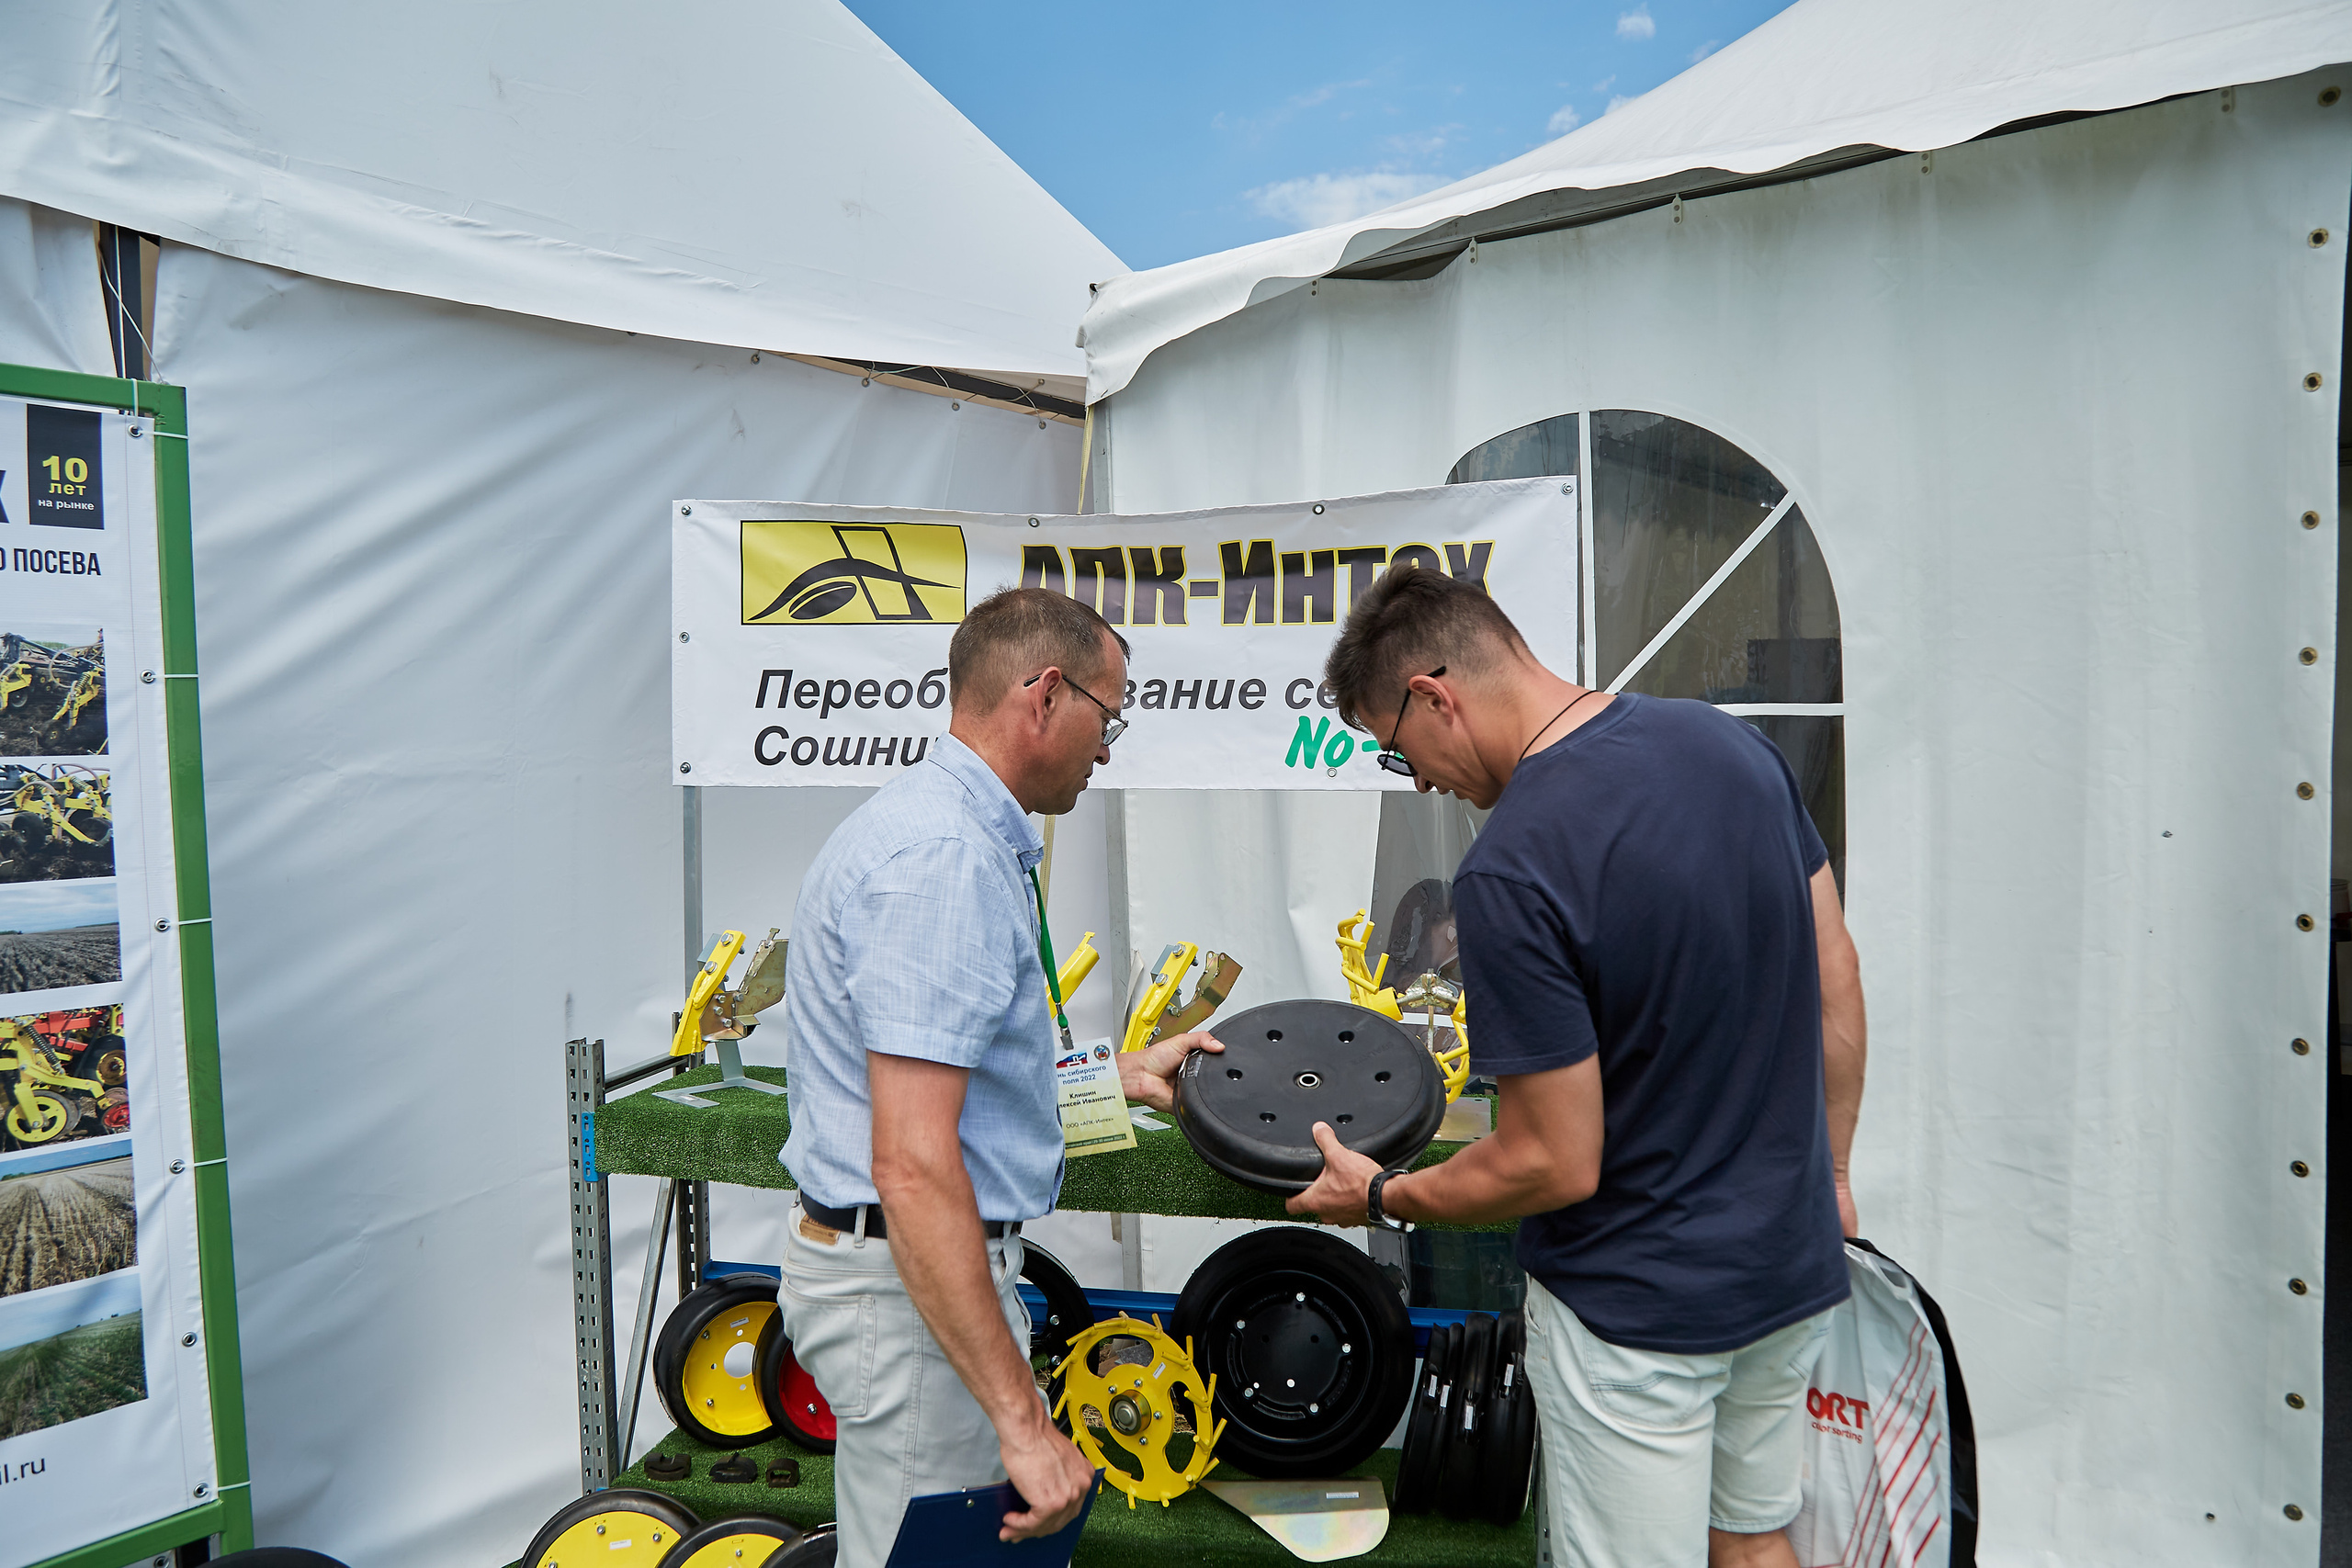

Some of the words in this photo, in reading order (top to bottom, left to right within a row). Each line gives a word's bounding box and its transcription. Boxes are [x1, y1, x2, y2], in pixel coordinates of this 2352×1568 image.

[42, 456, 88, 483] 10
[49, 483, 86, 496] лет
[39, 499, 54, 508] на
[56, 500, 95, 511] рынке
[14, 548, 102, 576] ПОСЕВА
[754, 726, 939, 766] Сошни
[1068, 1066, 1107, 1077] сибирского
[1059, 1100, 1081, 1109] лексей
[1832, 1427, 1863, 1444] sorting
